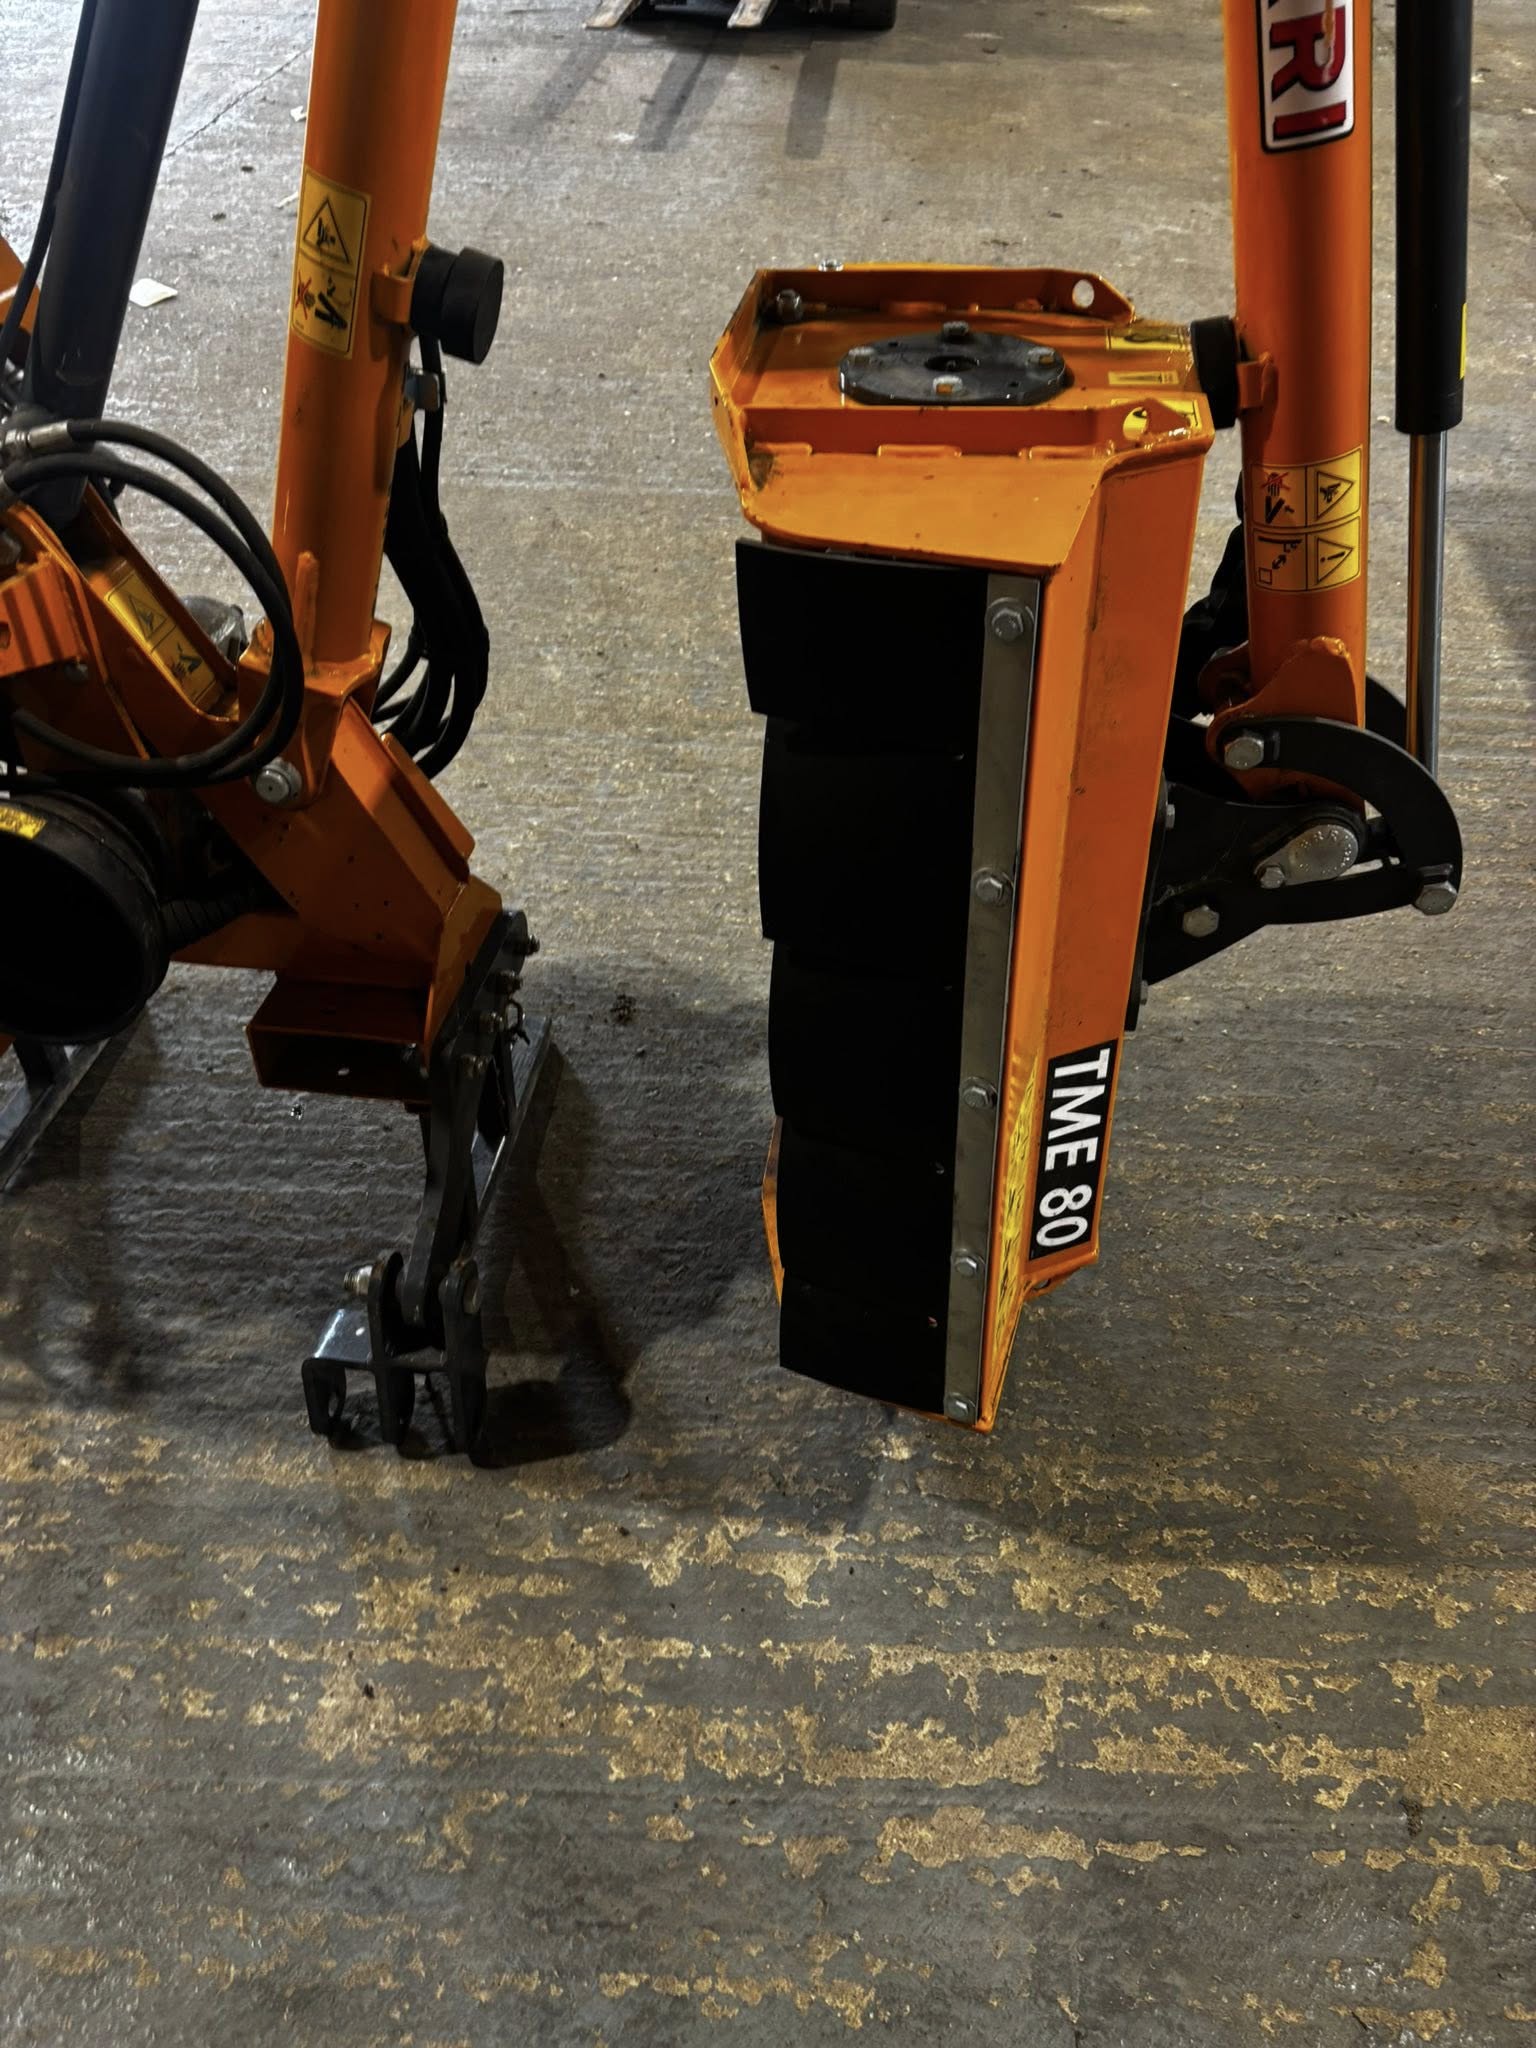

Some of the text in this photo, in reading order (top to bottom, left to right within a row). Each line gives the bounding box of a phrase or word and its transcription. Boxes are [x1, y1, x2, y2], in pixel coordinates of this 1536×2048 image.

[1268, 0, 1347, 142] RI
[1036, 1048, 1110, 1246] TME 80
